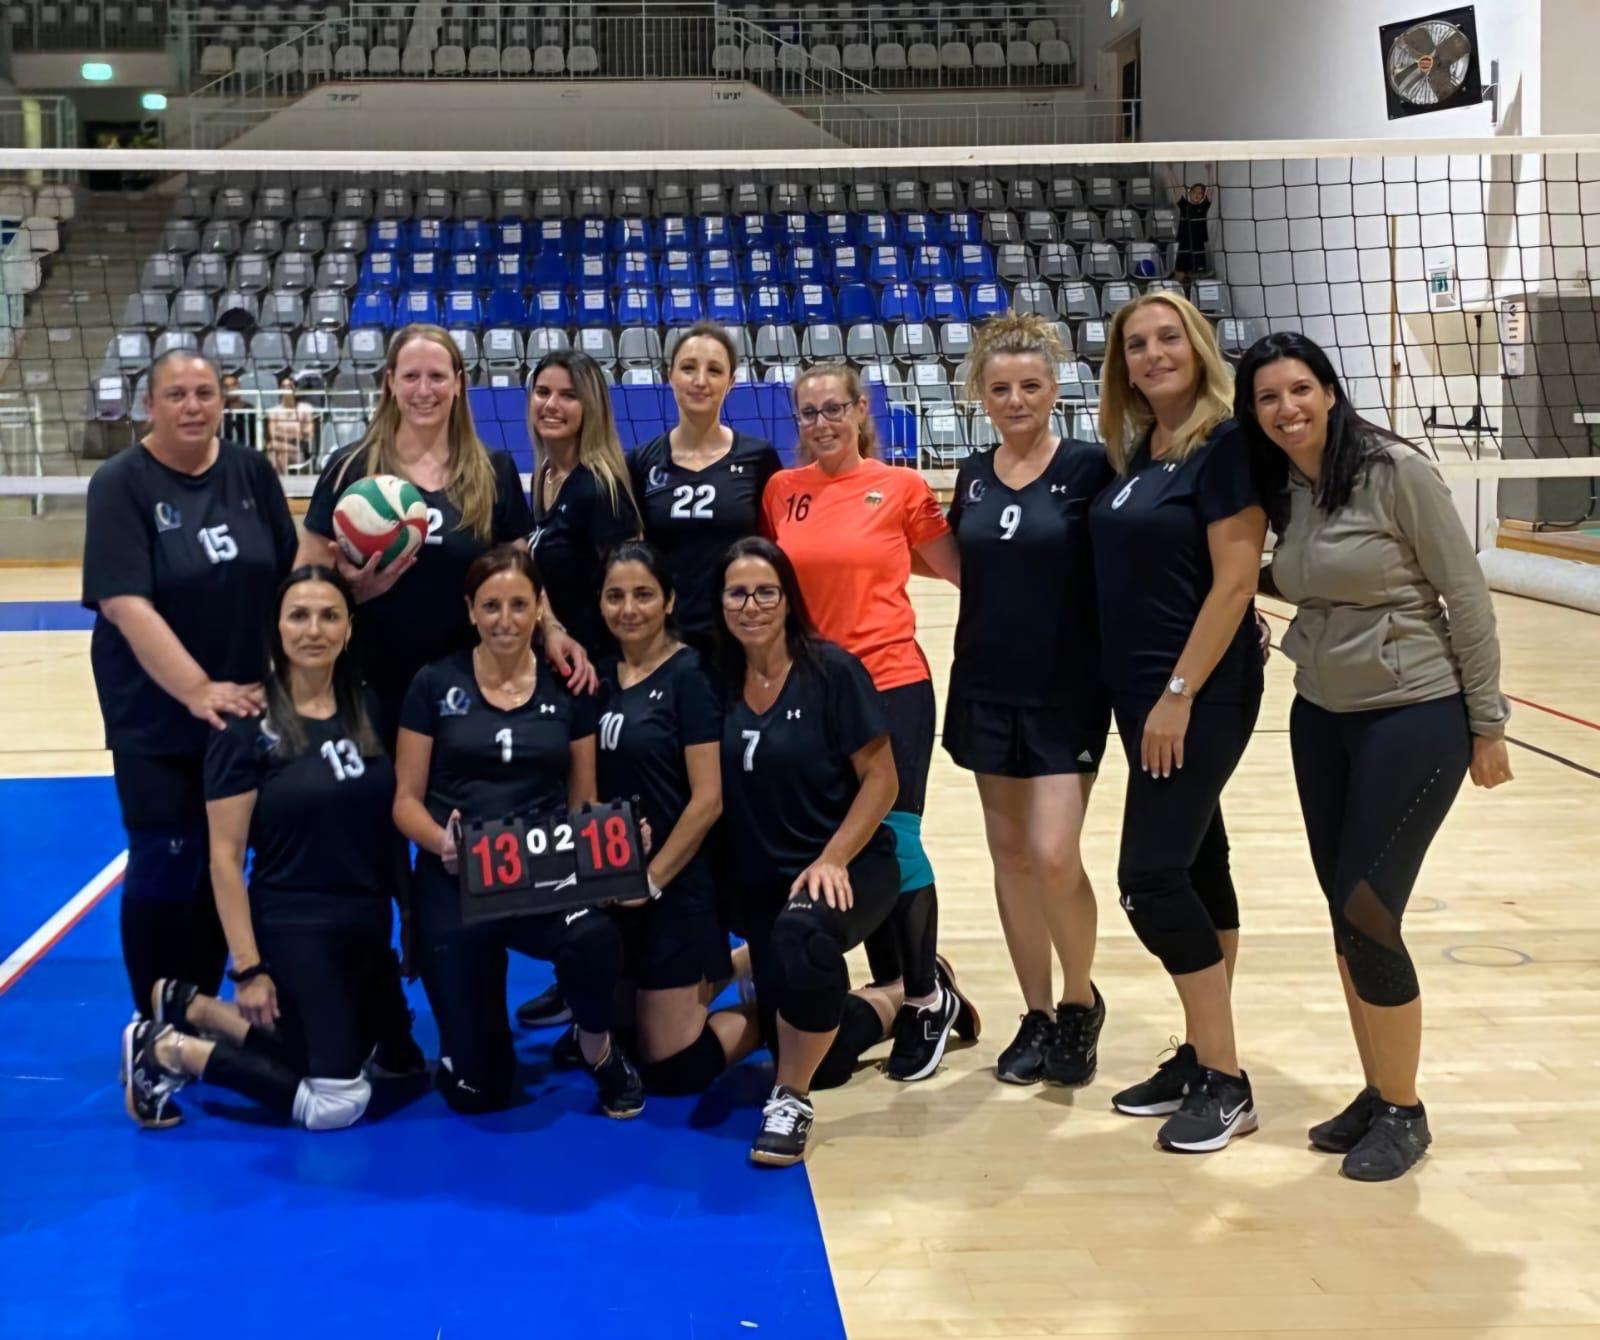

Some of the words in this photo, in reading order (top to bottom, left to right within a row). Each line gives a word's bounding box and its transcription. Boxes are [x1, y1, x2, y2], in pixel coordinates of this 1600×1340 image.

[670, 484, 716, 519] 22
[786, 492, 812, 523] 16
[1111, 476, 1140, 510] 6
[1000, 504, 1022, 540] 9
[196, 523, 239, 564] 15
[495, 728, 513, 762] 1
[598, 711, 625, 751] 10
[320, 738, 365, 782] 13
[741, 729, 761, 772] 7
[472, 834, 522, 887] 13
[580, 815, 631, 870] 18
